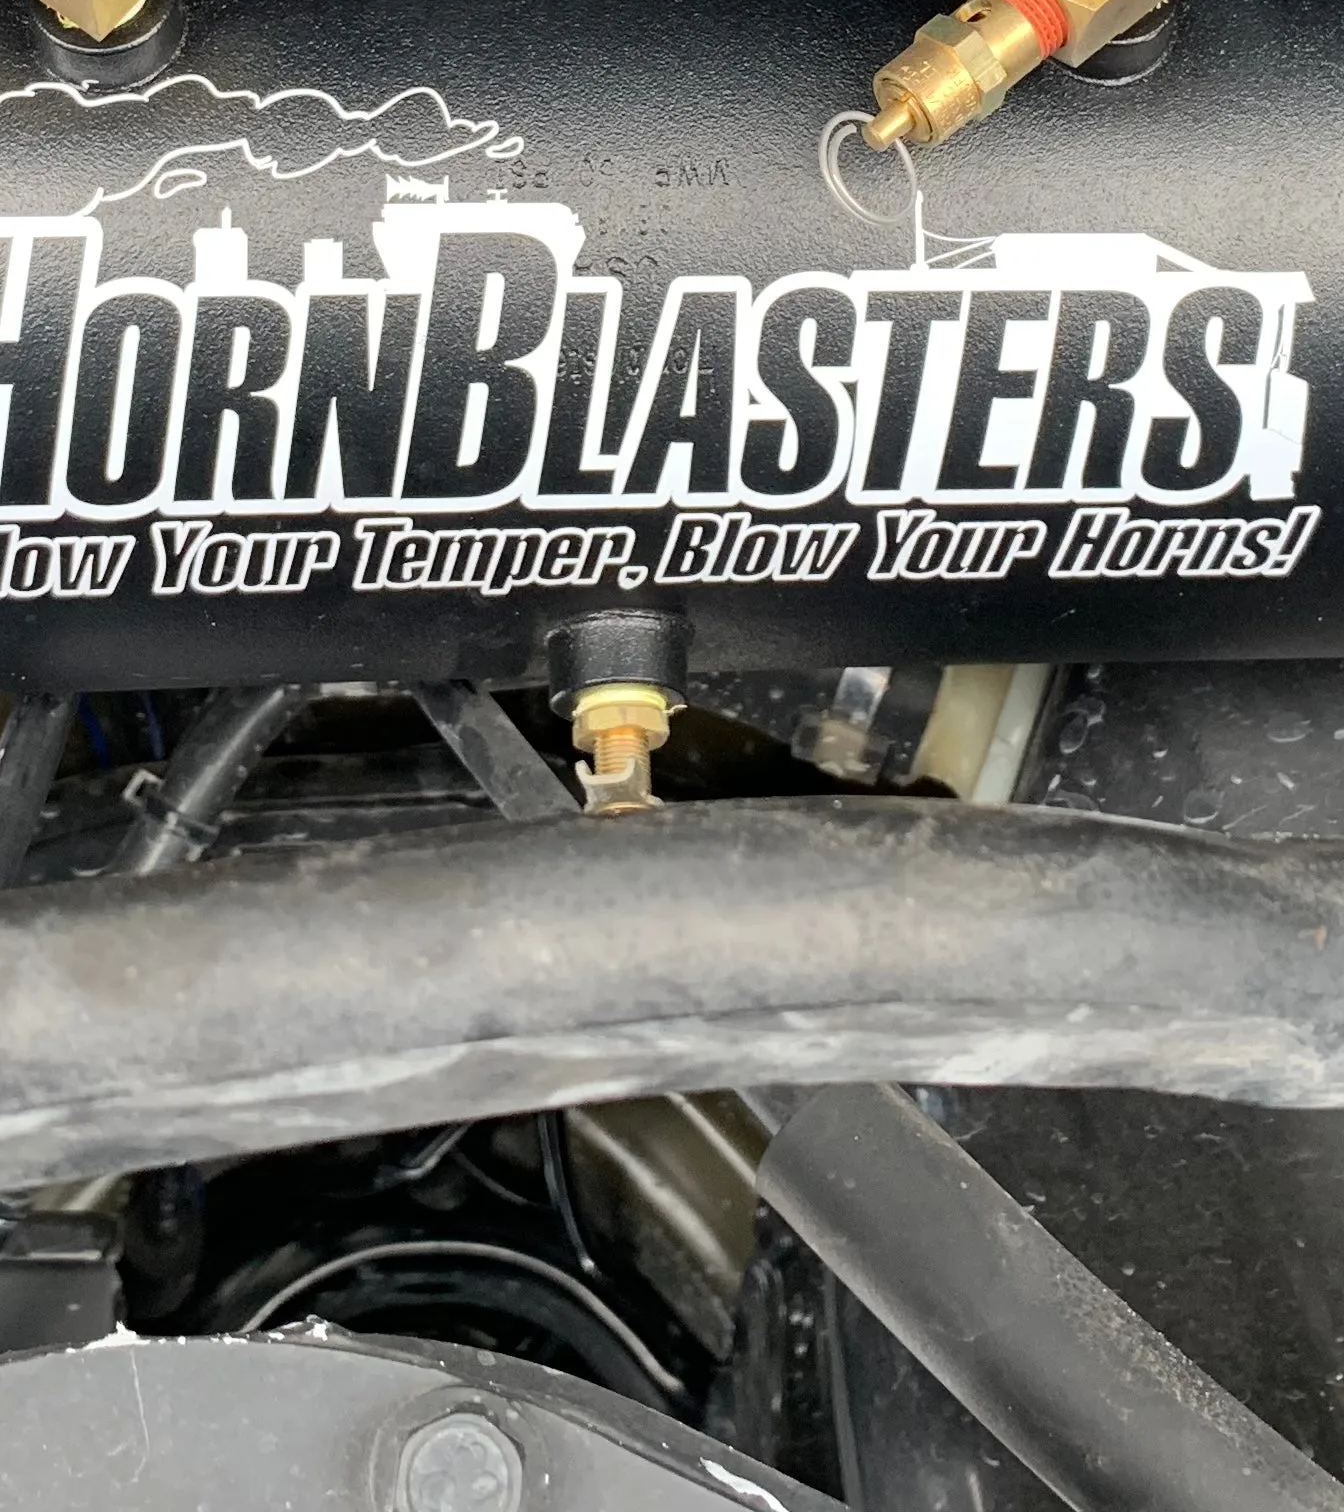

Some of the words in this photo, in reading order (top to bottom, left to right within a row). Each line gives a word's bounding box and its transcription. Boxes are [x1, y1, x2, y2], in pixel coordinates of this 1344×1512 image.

[150, 521, 341, 595] Your
[654, 512, 860, 584] Blow
[867, 510, 1046, 581] Your
[1050, 504, 1321, 580] Horns!
